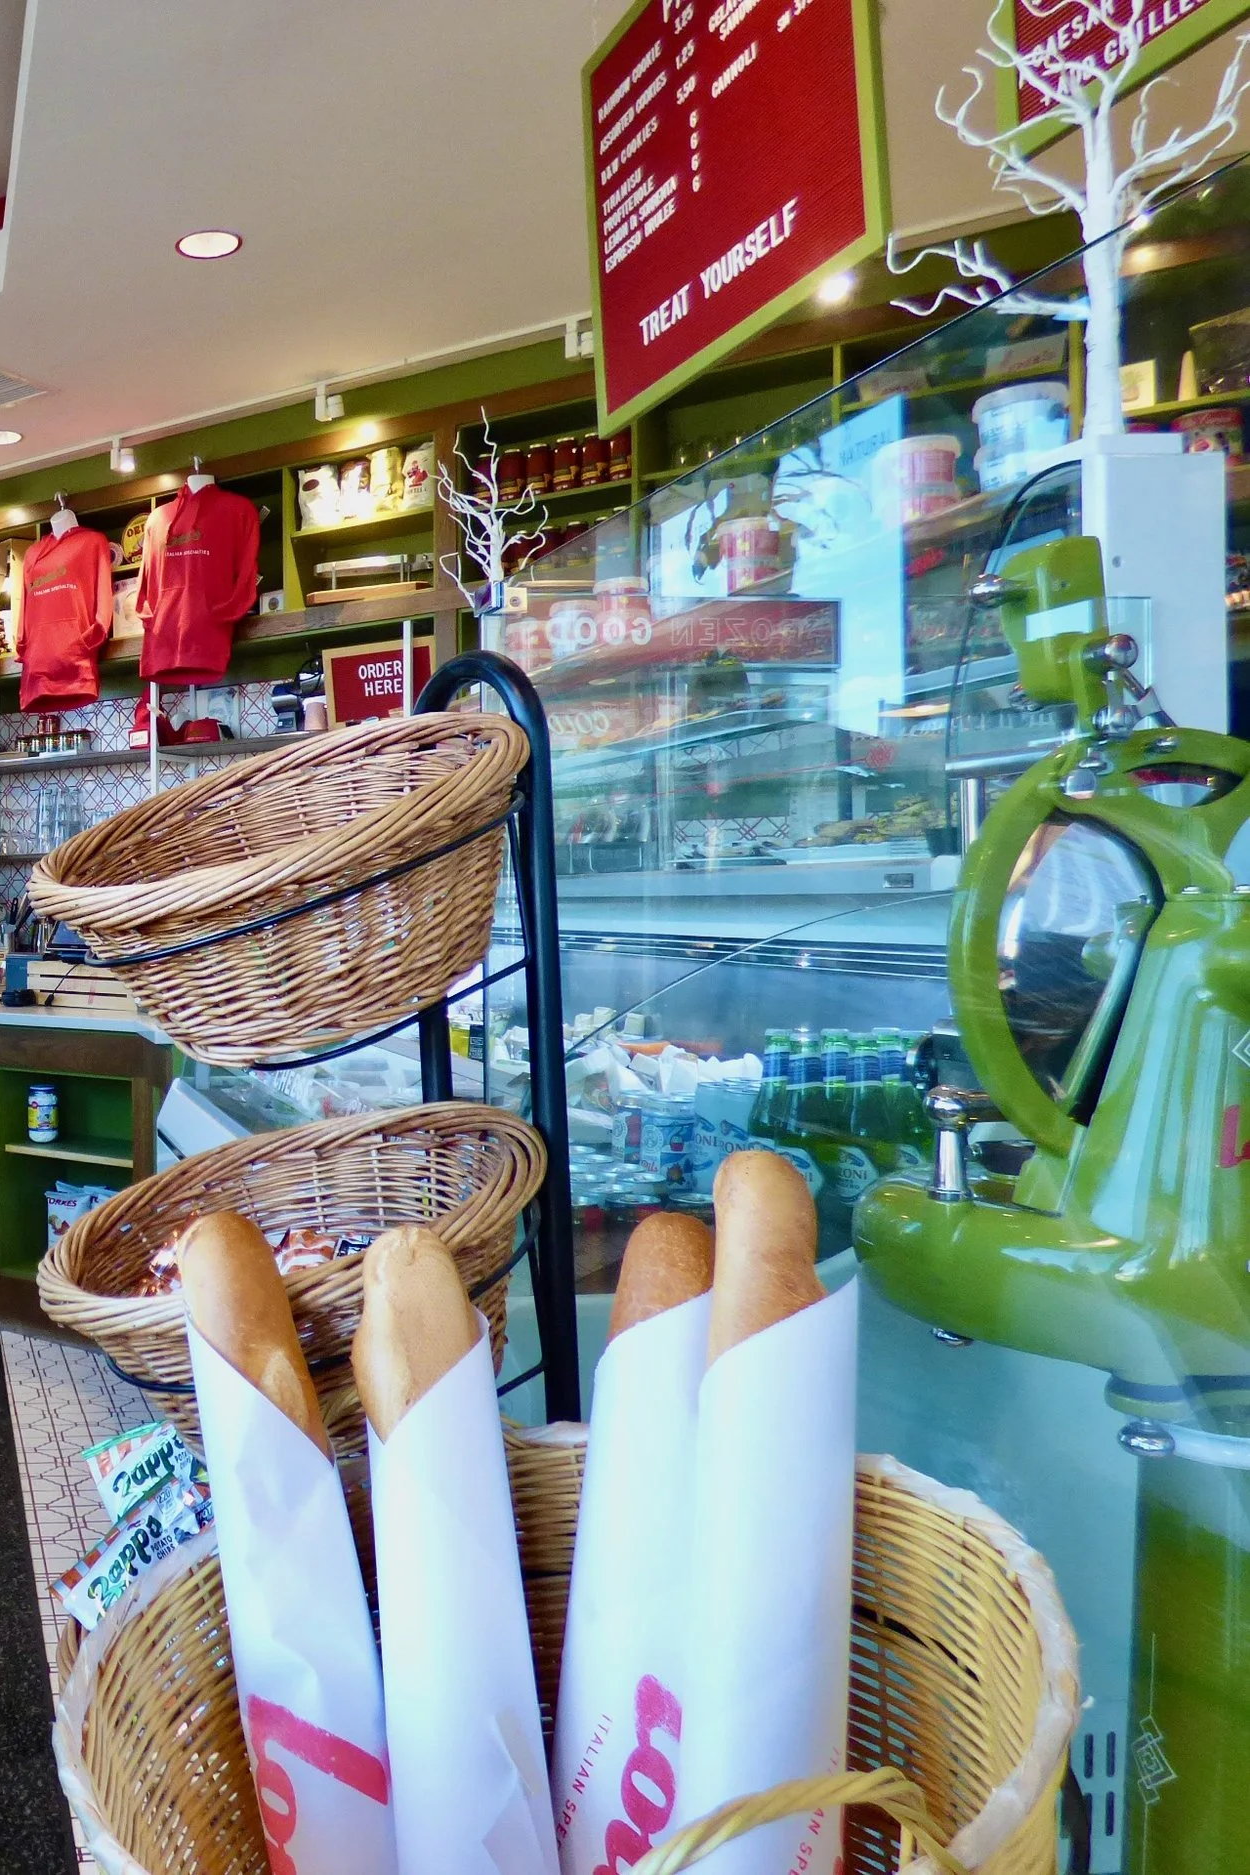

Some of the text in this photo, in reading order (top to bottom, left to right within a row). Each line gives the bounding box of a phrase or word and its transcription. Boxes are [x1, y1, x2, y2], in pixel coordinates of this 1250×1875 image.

[631, 40, 662, 83] COOKIE
[711, 40, 757, 98] CANNOLI
[635, 71, 667, 114] COOKIES
[620, 115, 658, 164] COOKIES
[689, 110, 698, 128] 6
[690, 131, 699, 150] 6
[691, 153, 700, 171] 6
[692, 175, 701, 192] 6
[602, 166, 643, 216] TIRAMISU
[605, 229, 642, 274] ESPRESSO
[639, 196, 799, 346] TREAT YOURSELF
[358, 660, 403, 680] ORDER
[364, 678, 403, 697] HERE
[151, 1535, 173, 1552] POTATO
[157, 1544, 176, 1560] CHIPS
[556, 1713, 614, 1850] ITALIAN SPE
